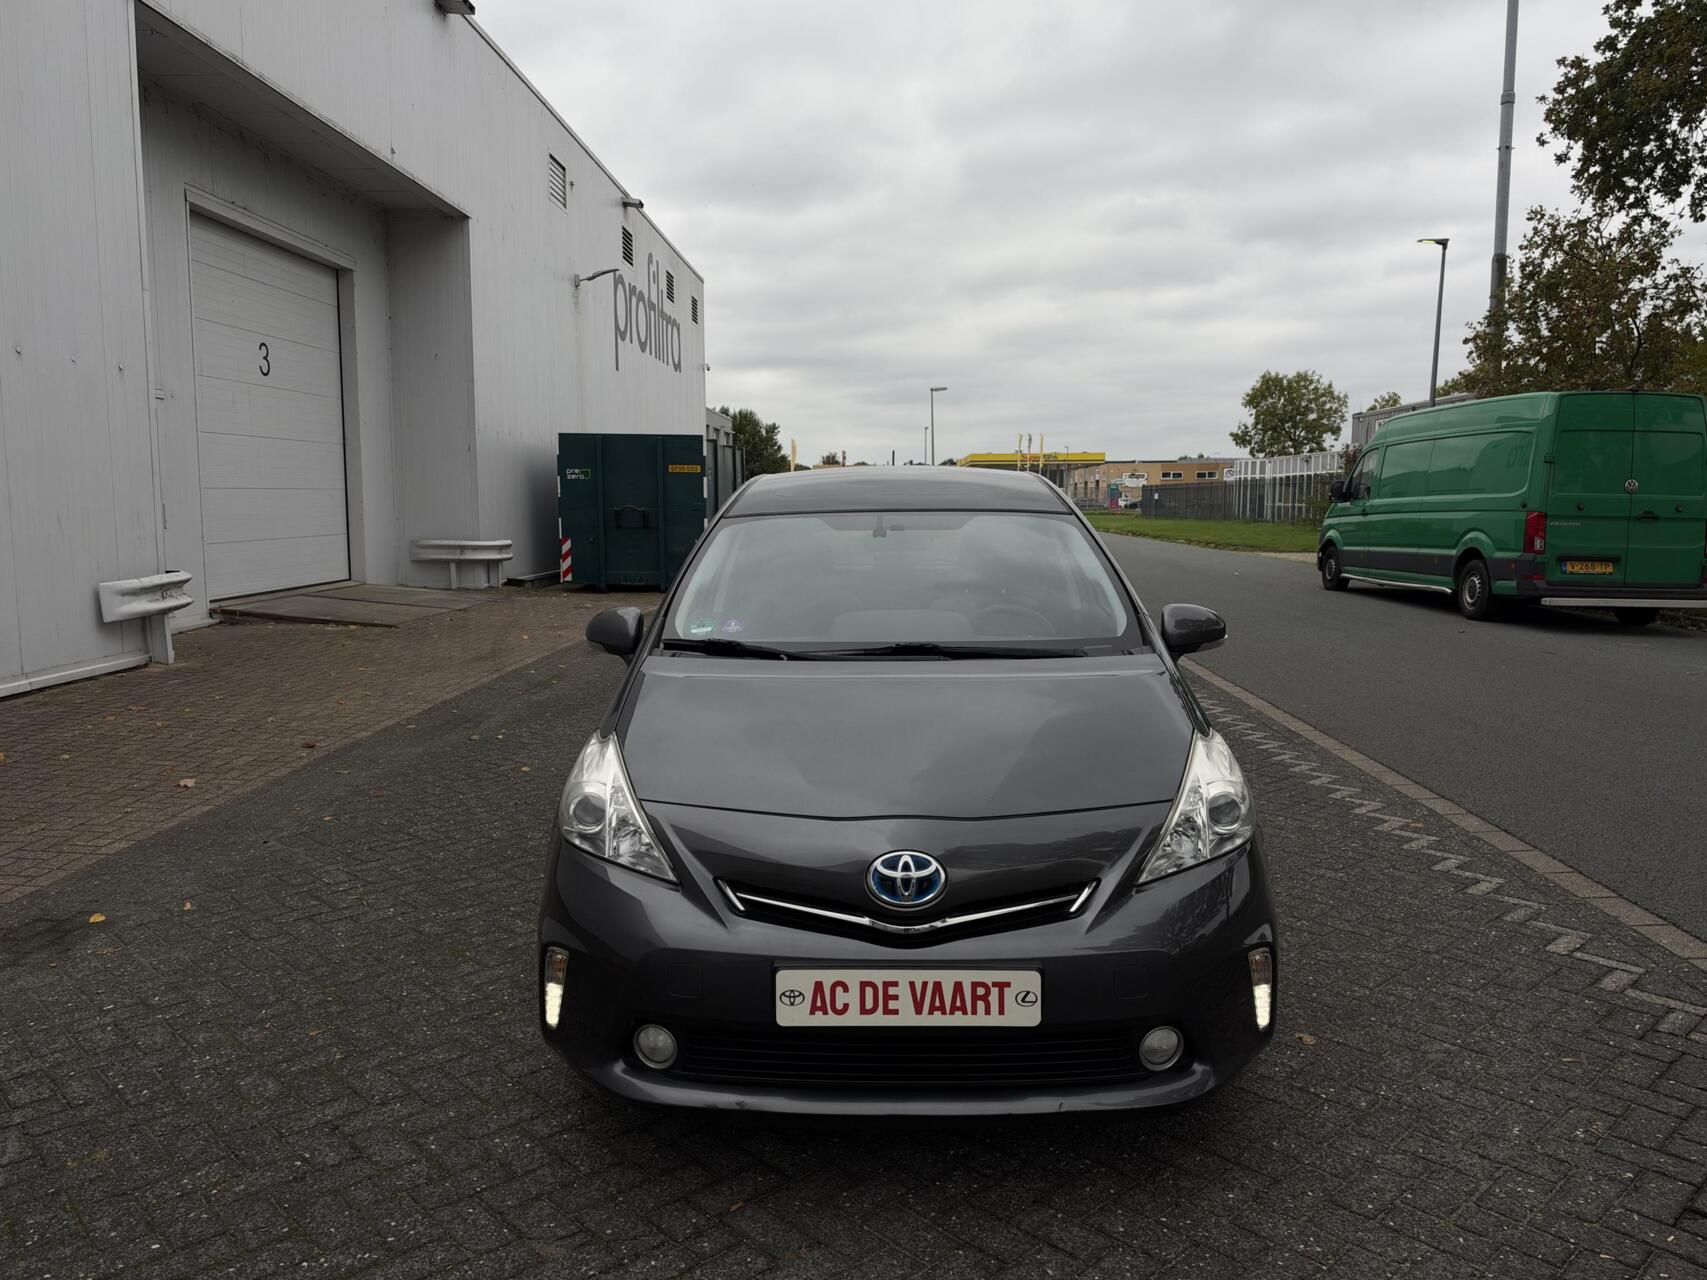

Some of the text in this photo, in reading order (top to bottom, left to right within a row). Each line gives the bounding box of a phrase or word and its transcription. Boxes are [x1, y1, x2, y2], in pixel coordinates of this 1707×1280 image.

[613, 252, 681, 373] profiltra
[259, 342, 270, 376] 3
[808, 980, 1012, 1016] AC DE VAART
